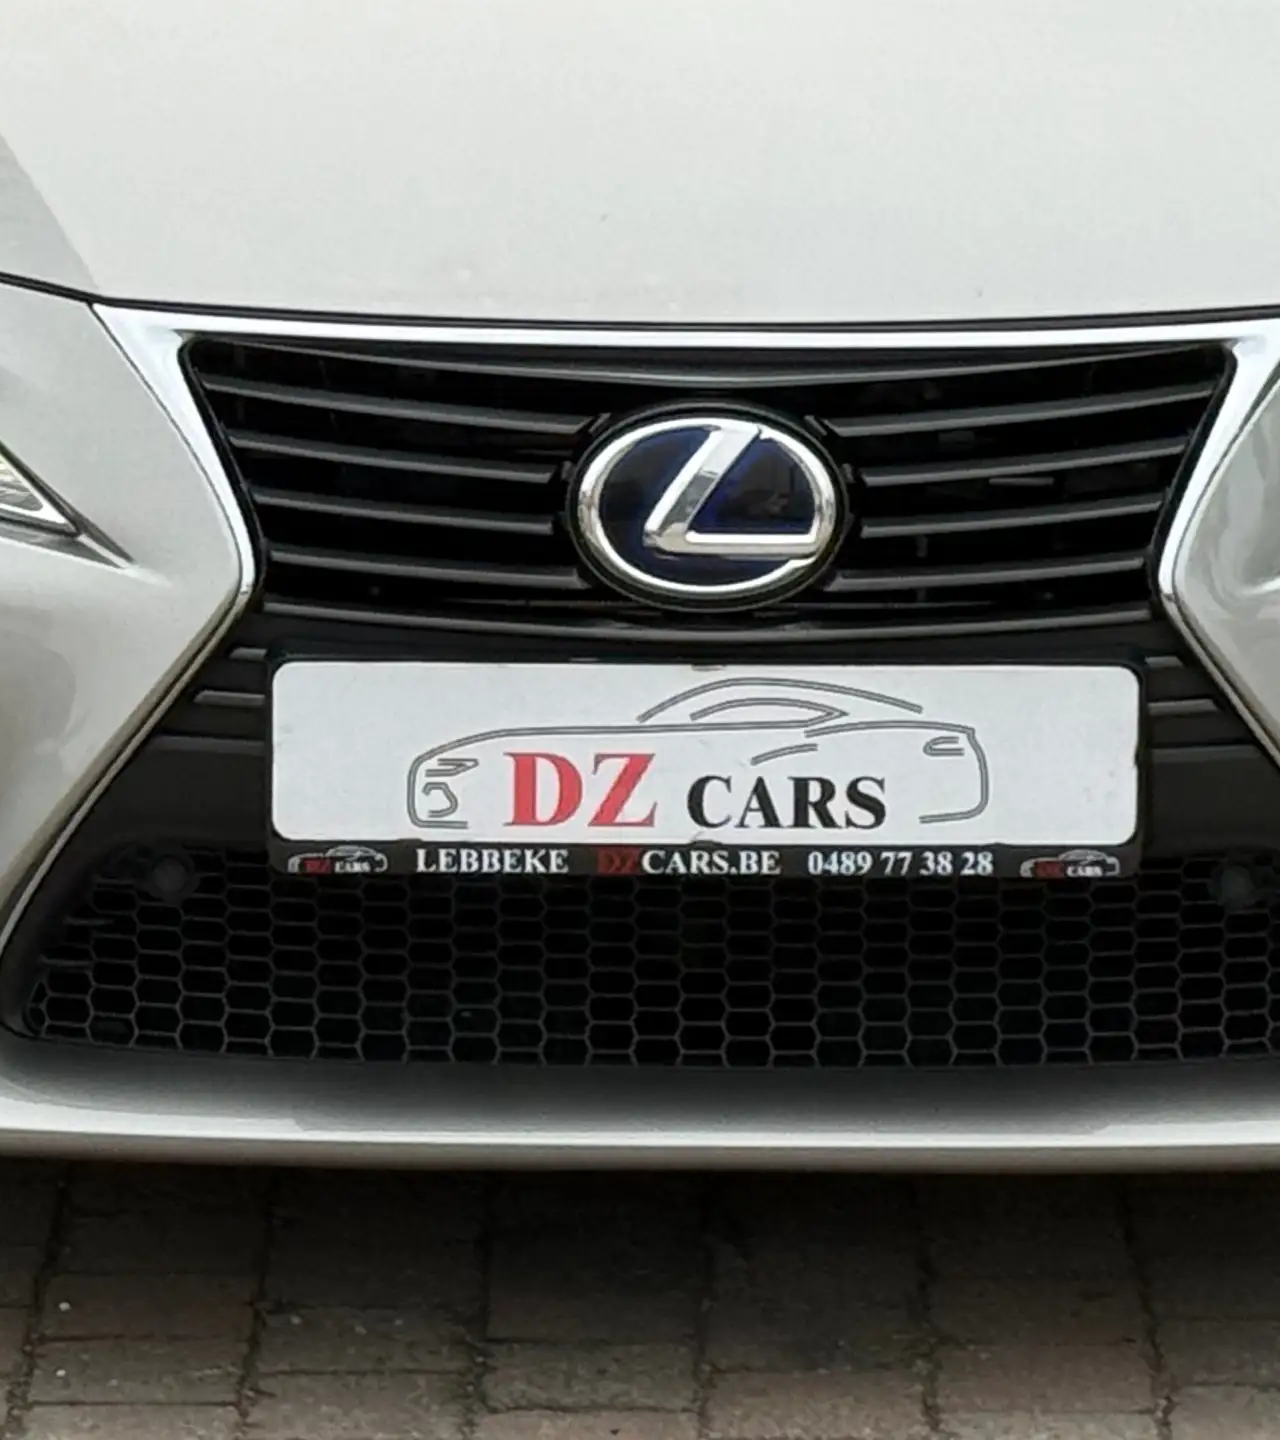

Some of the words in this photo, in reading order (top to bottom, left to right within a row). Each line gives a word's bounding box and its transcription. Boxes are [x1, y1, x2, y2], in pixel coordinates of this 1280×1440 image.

[505, 753, 656, 827] DZ
[686, 775, 887, 830] CARS
[416, 848, 569, 874] LEBBEKE
[807, 851, 873, 876] 0489
[880, 851, 913, 876] 77
[919, 851, 953, 876] 38
[960, 851, 994, 876] 28
